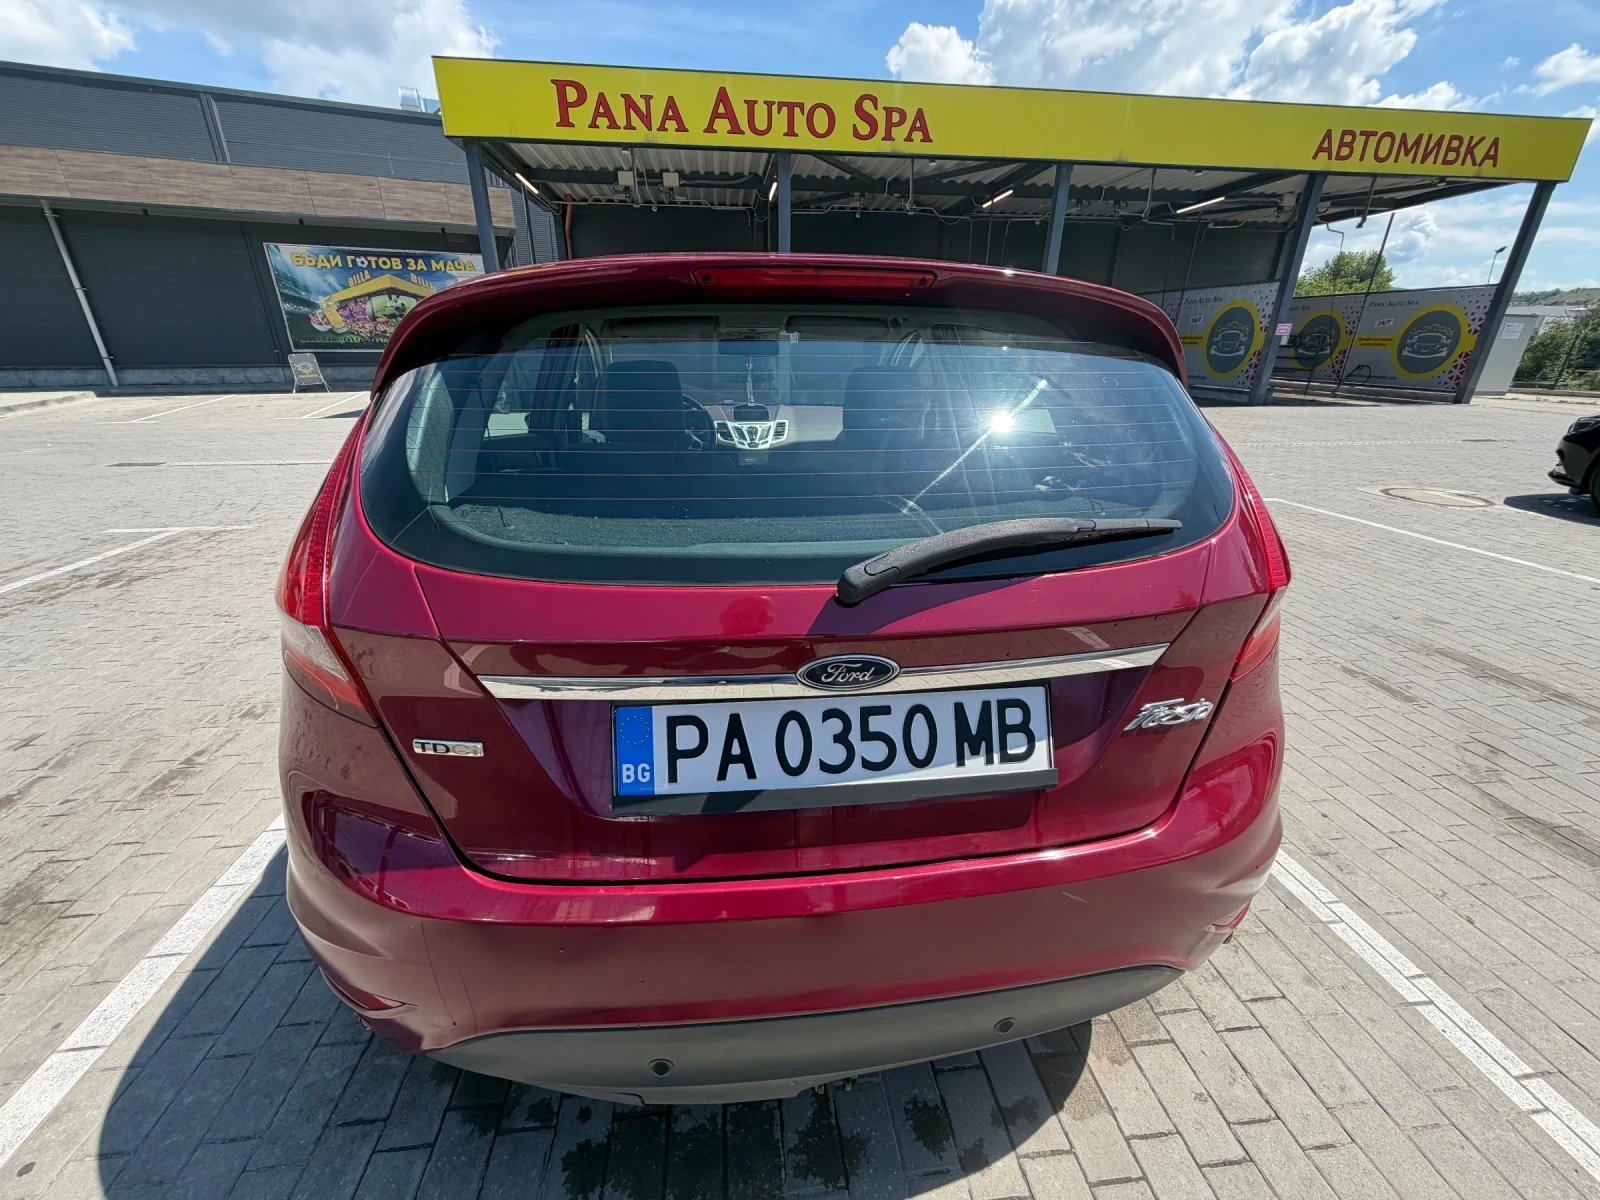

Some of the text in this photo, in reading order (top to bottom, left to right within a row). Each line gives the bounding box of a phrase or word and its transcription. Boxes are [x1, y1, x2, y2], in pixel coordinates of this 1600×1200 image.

[551, 79, 933, 142] PANA AUTO SPA
[1312, 128, 1500, 168] АВТОМИВКА
[291, 252, 342, 269] БЪДИ
[407, 256, 428, 271] ЗА
[431, 259, 476, 272] МАЧА
[348, 269, 371, 288] BILLA
[410, 272, 436, 292] BILLA
[1377, 319, 1391, 327] 24/7
[821, 662, 875, 682] Ford
[666, 698, 1037, 784] PA 0350 MB
[622, 764, 650, 784] BG
